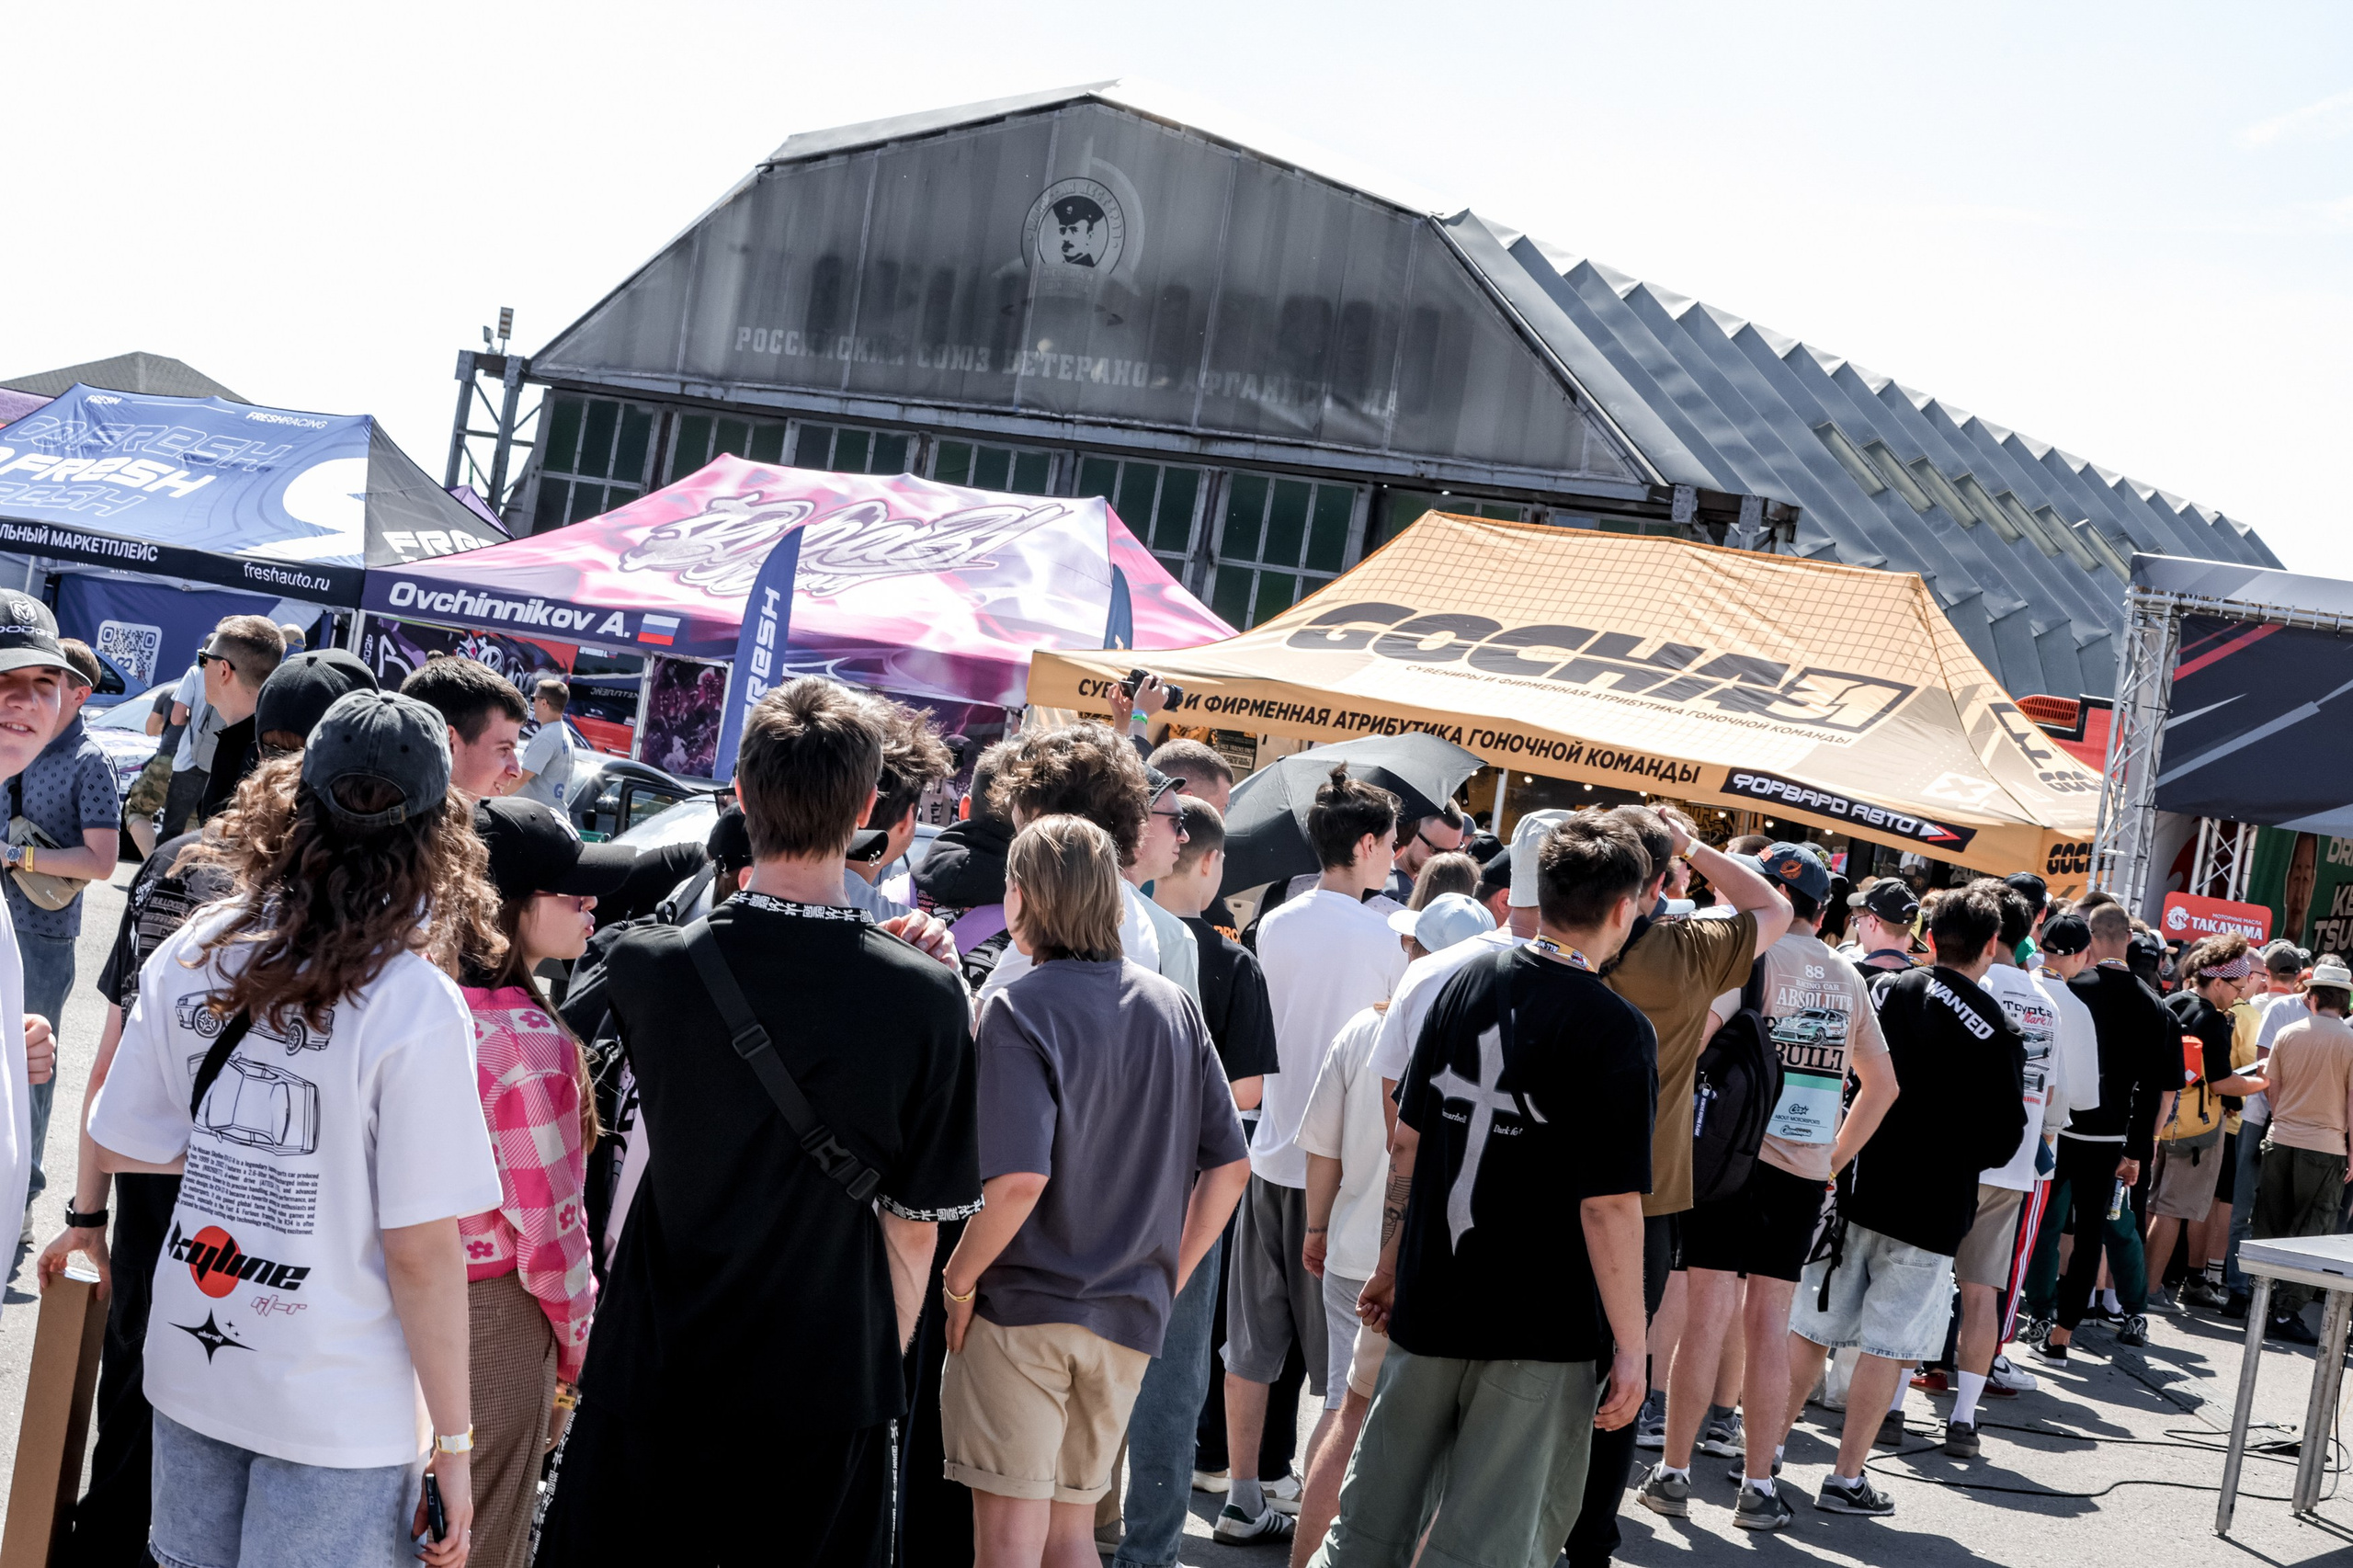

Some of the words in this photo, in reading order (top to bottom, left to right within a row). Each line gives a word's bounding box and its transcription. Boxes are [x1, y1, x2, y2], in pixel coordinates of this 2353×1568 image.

[245, 411, 328, 429] FRESHRACING
[0, 524, 48, 545] ЛЬНЫЙ
[51, 530, 159, 562] МАРКЕТПЛЕЙС
[244, 562, 330, 592] freshauto.ru
[389, 581, 596, 631] Ovchinnikov
[597, 610, 631, 639] A.
[1405, 665, 1483, 681] СУВЕНИРЫ
[1498, 678, 1590, 698] ФИРМЕННАЯ
[1592, 691, 1684, 716] АТРИБУТИКА
[1686, 710, 1770, 731] ГОНОЧНОЙ
[1772, 724, 1853, 745] КОМАНДЫ
[1185, 693, 1202, 710] И
[1204, 694, 1331, 727] ФИРМЕННАЯ
[1333, 710, 1463, 745] АТРИБУТИКА
[1467, 727, 1583, 767] ГОНОЧНОЙ
[1584, 747, 1702, 784] КОМАНДЫ
[2191, 916, 2263, 940] TAKAYAMA
[1804, 964, 1824, 979] 88
[1795, 979, 1821, 990] RACING
[1823, 983, 1839, 991] CAR
[1776, 986, 1853, 1012] ABSOLUTE
[1926, 977, 1995, 1040] WANTED
[2003, 1000, 2053, 1018] Toyota
[2023, 1012, 2045, 1026] Mark
[244, 1161, 267, 1170] legendary
[231, 1183, 247, 1191] precise
[237, 1199, 252, 1208] global
[251, 1195, 268, 1203] favorite
[236, 1216, 262, 1227] technology
[242, 1209, 259, 1217] Furious
